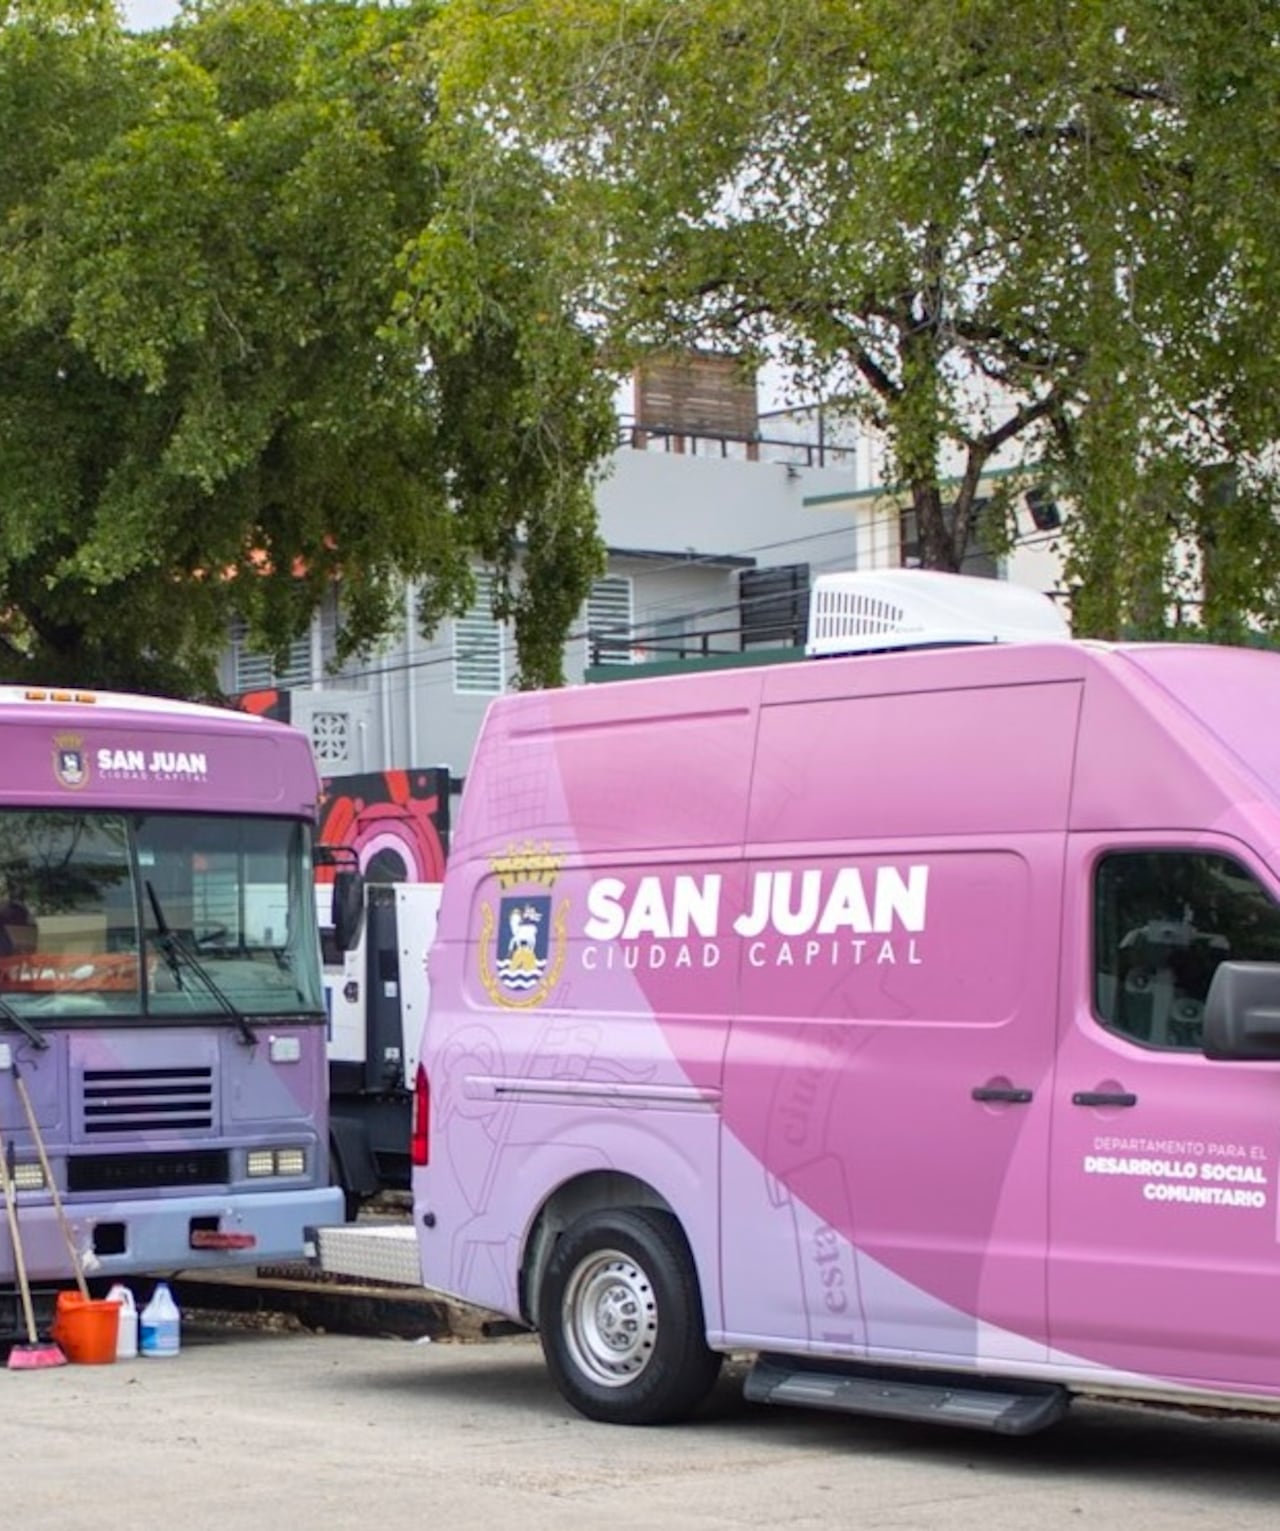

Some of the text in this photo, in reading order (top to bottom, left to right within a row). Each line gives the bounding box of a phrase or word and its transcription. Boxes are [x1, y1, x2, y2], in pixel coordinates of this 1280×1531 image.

[97, 749, 207, 774] SAN JUAN
[583, 865, 929, 941] SAN JUAN
[582, 940, 922, 969] CIUDAD CAPITAL
[1093, 1137, 1267, 1160] DEPARTAMENTO PARA EL
[1084, 1156, 1267, 1183] DESARROLLO SOCIAL
[1143, 1183, 1266, 1207] COMUNITARIO
